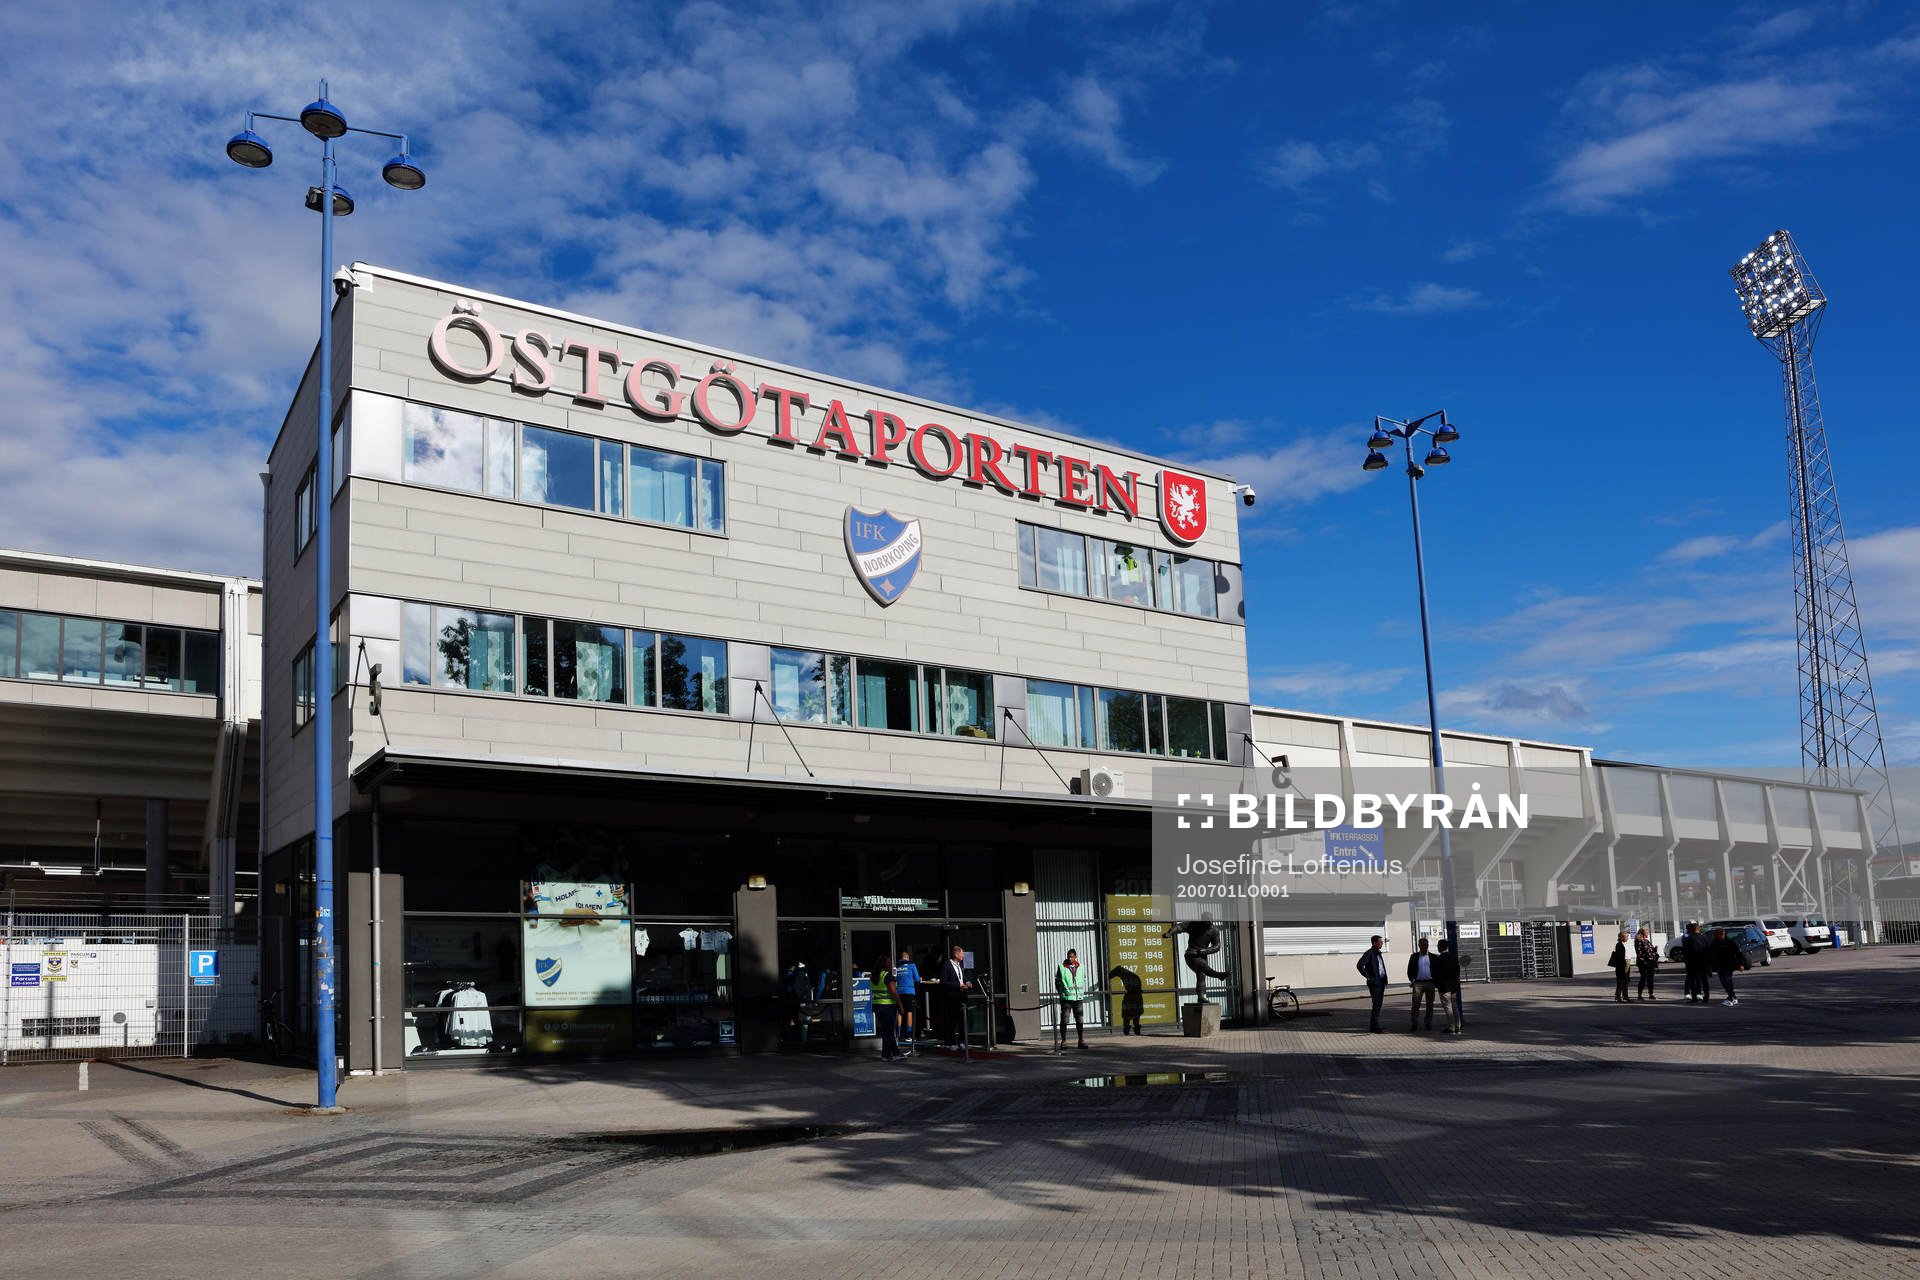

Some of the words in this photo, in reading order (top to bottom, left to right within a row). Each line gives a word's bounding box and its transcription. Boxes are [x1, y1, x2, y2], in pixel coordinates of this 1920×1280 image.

[428, 298, 1140, 518] ÖSTGÖTAPORTEN
[856, 521, 888, 541] IFK
[863, 533, 919, 573] NORRKÖPING
[1333, 846, 1357, 857] Entré
[864, 896, 922, 905] Välkommen
[1142, 908, 1160, 916] 1963
[1143, 925, 1162, 933] 1960
[1118, 938, 1137, 946] 1957
[1119, 952, 1138, 960] 1952
[1144, 951, 1163, 959] 1948
[199, 954, 213, 973] P
[1145, 964, 1164, 973] 1946
[1146, 977, 1165, 985] 1943
